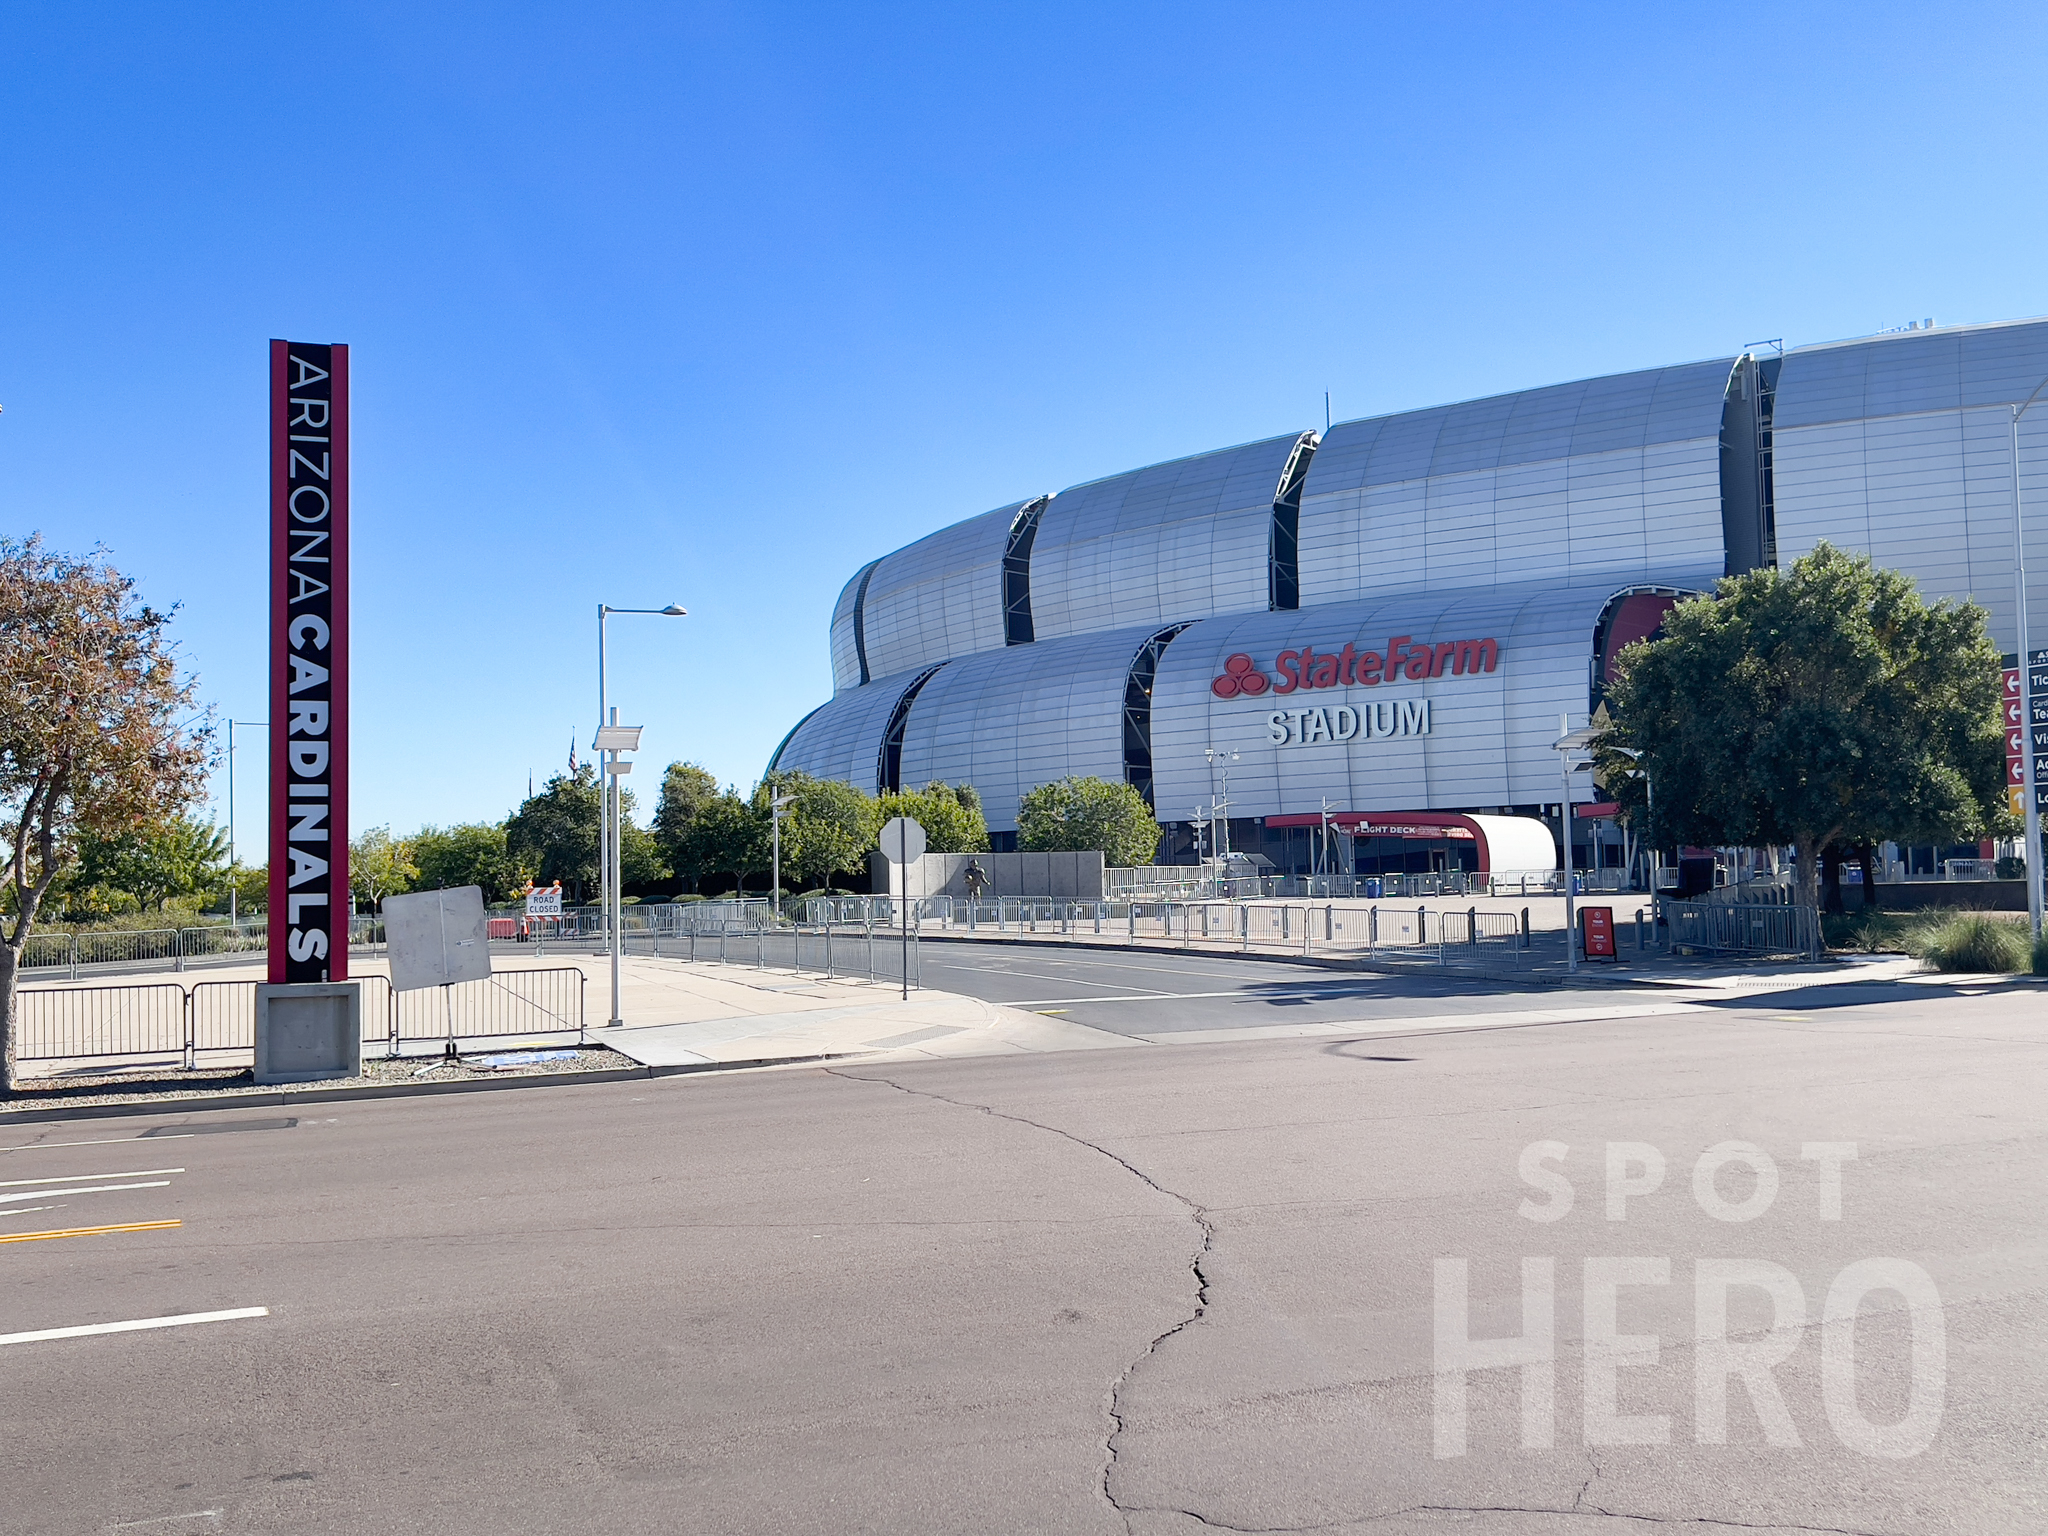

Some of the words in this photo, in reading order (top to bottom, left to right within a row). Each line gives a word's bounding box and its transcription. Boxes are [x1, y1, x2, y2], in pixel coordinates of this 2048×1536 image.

[288, 354, 330, 606] ARIZONA
[1266, 699, 1432, 746] STADIUM
[2035, 733, 2048, 744] Vi
[288, 613, 330, 963] CARDINALS
[1390, 826, 1416, 834] DECK
